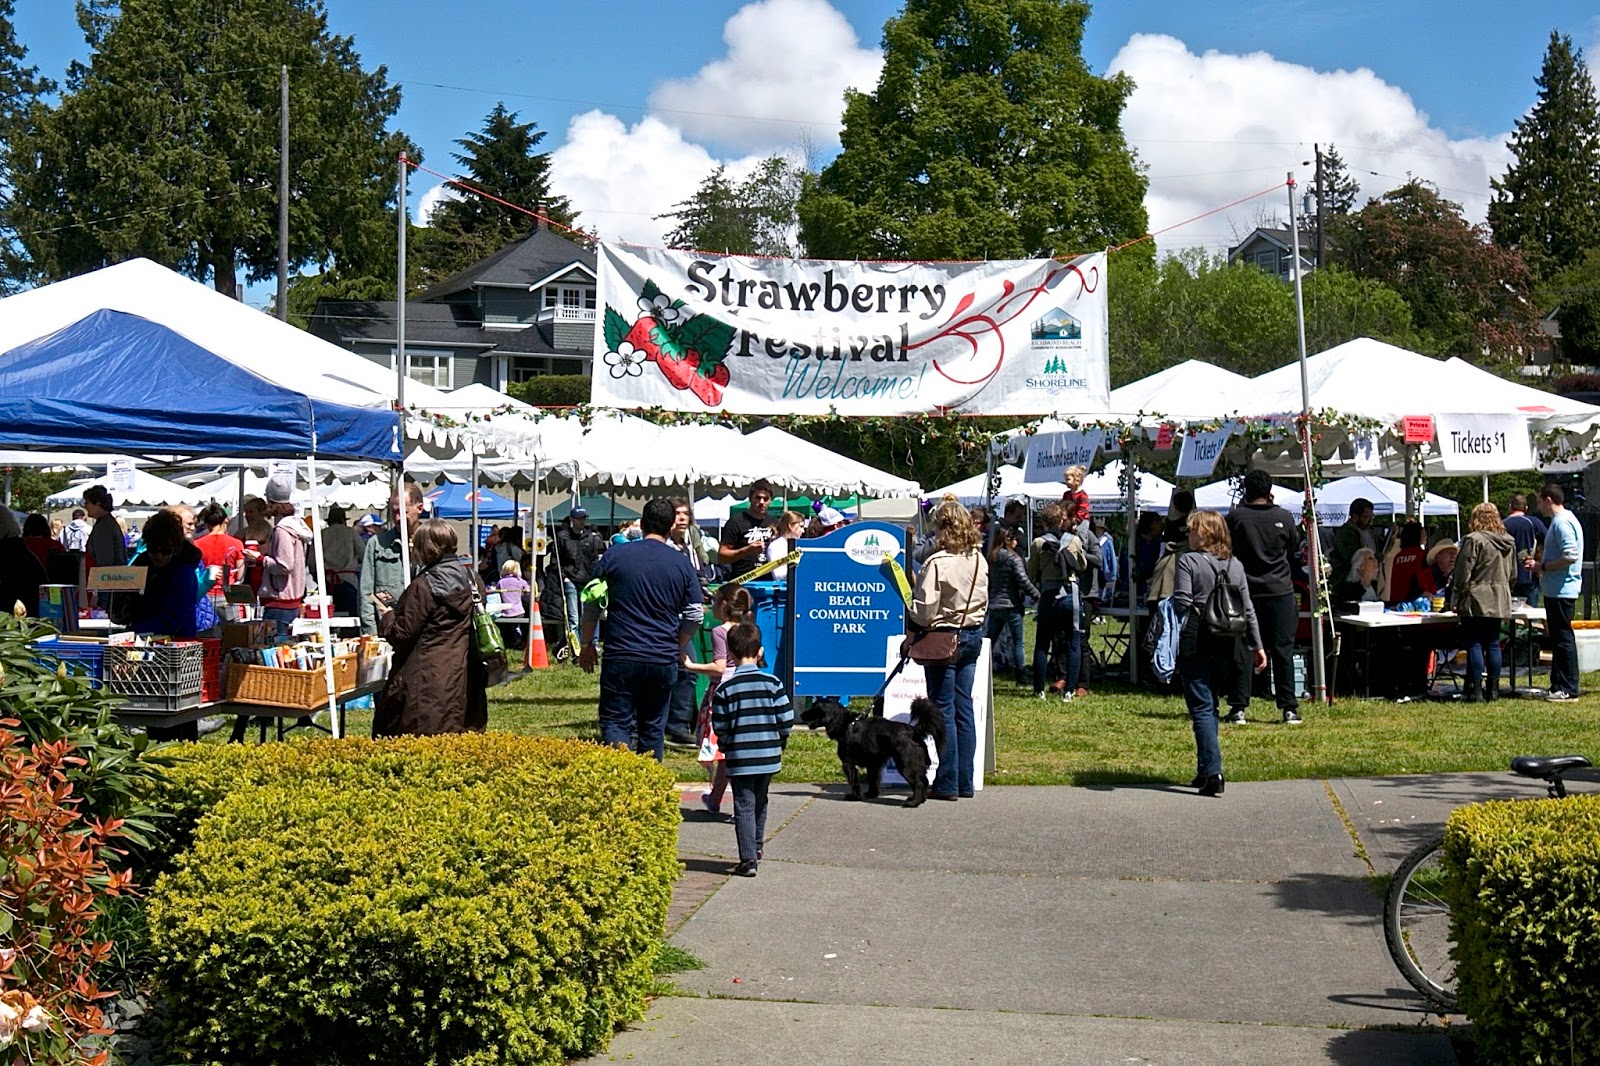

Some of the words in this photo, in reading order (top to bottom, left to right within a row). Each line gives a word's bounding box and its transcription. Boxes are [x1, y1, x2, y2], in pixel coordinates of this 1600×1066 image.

[684, 260, 946, 320] Strawberry
[782, 353, 927, 400] Welcome!
[1026, 378, 1087, 388] SHORELINE
[1451, 430, 1492, 454] Tickets
[1494, 432, 1507, 454] $1
[1194, 438, 1217, 461] Tickets
[1036, 448, 1063, 469] Richmond
[1063, 446, 1078, 466] Beach
[1078, 446, 1091, 463] Gear
[1396, 555, 1417, 564] STAFF
[101, 573, 135, 582] Childrens
[814, 581, 886, 593] RICHMOND
[829, 596, 871, 606] BEACH
[809, 609, 890, 620] COMMUNITY
[833, 623, 866, 633] PARK
